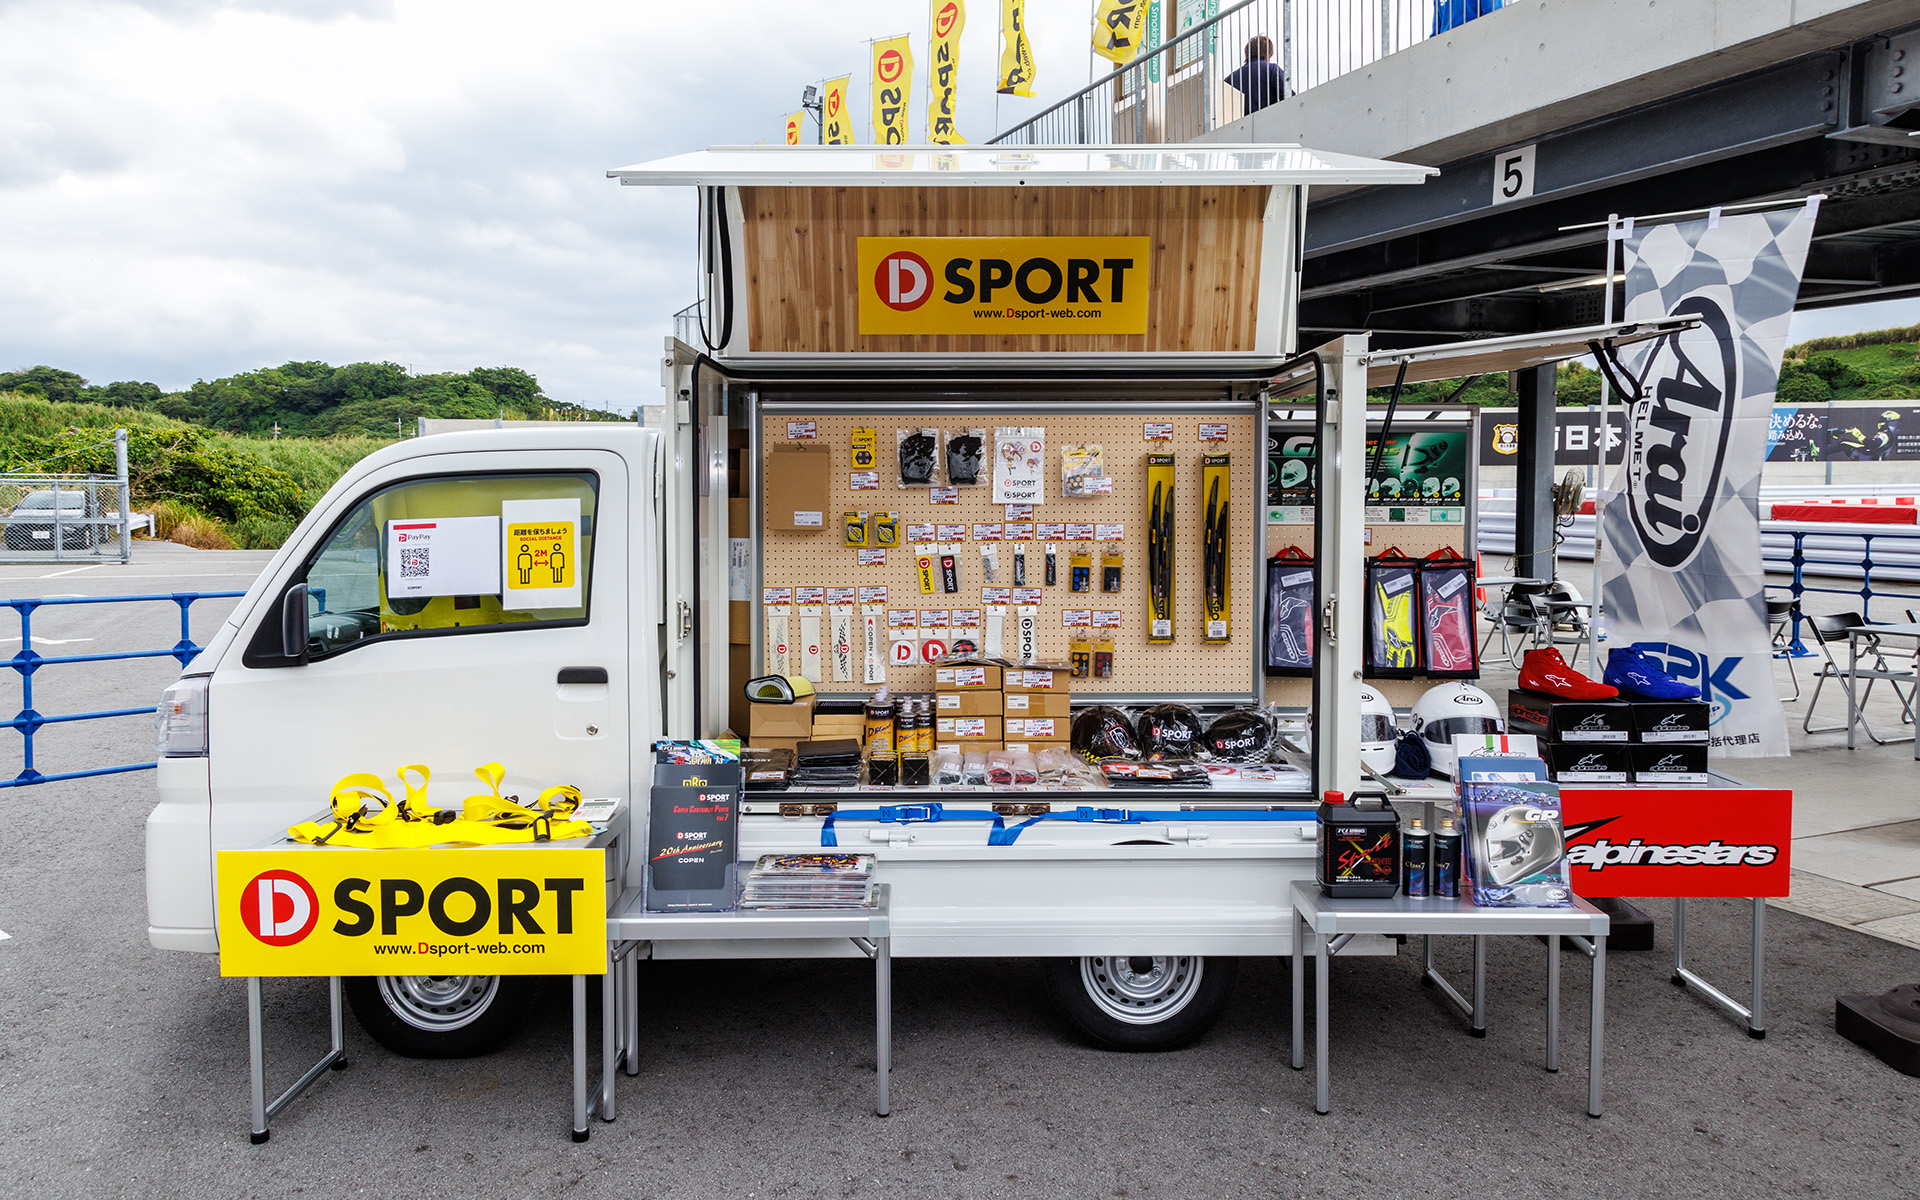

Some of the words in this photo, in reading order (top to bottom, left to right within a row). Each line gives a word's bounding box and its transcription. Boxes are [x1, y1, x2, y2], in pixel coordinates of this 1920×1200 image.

[1150, 6, 1160, 49] Smoking
[1502, 155, 1523, 198] 5
[886, 255, 931, 307] D
[943, 257, 1134, 304] SPORT
[973, 308, 1102, 320] www.Dsport-web.com
[1769, 413, 1822, 429] 決めるな。
[1554, 423, 1622, 452] 日本
[1632, 386, 1653, 482] HELMET
[1645, 330, 1722, 537] Arai
[513, 528, 567, 536] 距離を保ちましょう
[534, 549, 547, 557] 2M
[922, 570, 931, 591] SPORT
[945, 569, 954, 591] SPORT
[896, 644, 911, 660] D
[1023, 631, 1032, 659] SPOR
[1460, 695, 1481, 703] Arai
[1161, 729, 1192, 740] SPORT
[1706, 733, 1760, 747] 括代理店
[1224, 738, 1255, 749] SPORT
[1525, 810, 1559, 821] GP
[660, 846, 680, 856] 20th
[680, 840, 723, 854] Anniversary
[1566, 839, 1778, 872] alpinestars
[252, 874, 315, 941] D
[333, 876, 584, 937] SPORT
[374, 941, 545, 957] www.Dsport-web.com
